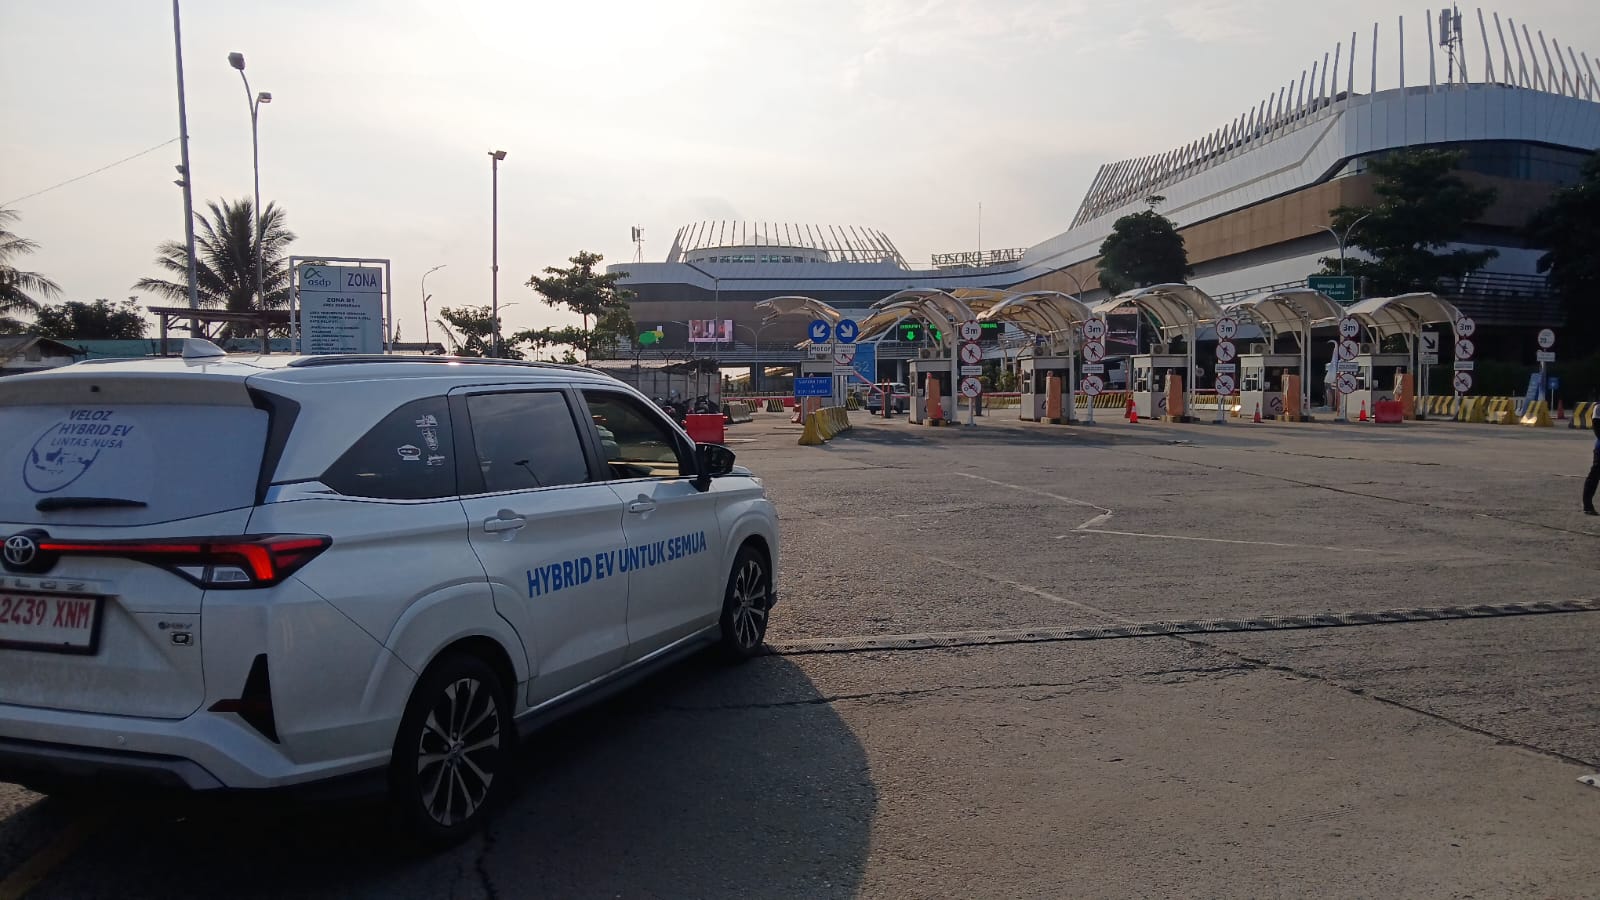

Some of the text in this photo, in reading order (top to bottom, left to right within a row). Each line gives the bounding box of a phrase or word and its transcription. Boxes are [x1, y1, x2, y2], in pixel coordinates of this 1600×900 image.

[931, 251, 982, 265] SOSORO
[308, 278, 332, 287] asdp
[347, 273, 377, 287] ZONA
[69, 409, 114, 421] VELOZ
[58, 423, 134, 437] HYBRID EV
[50, 437, 123, 448] LINTAS NUSA
[526, 530, 707, 598] HYBRID EV UNTUK SEMUA
[0, 578, 86, 591] LOZ
[0, 597, 91, 629] 2439 XNM
[172, 633, 190, 644] Q
